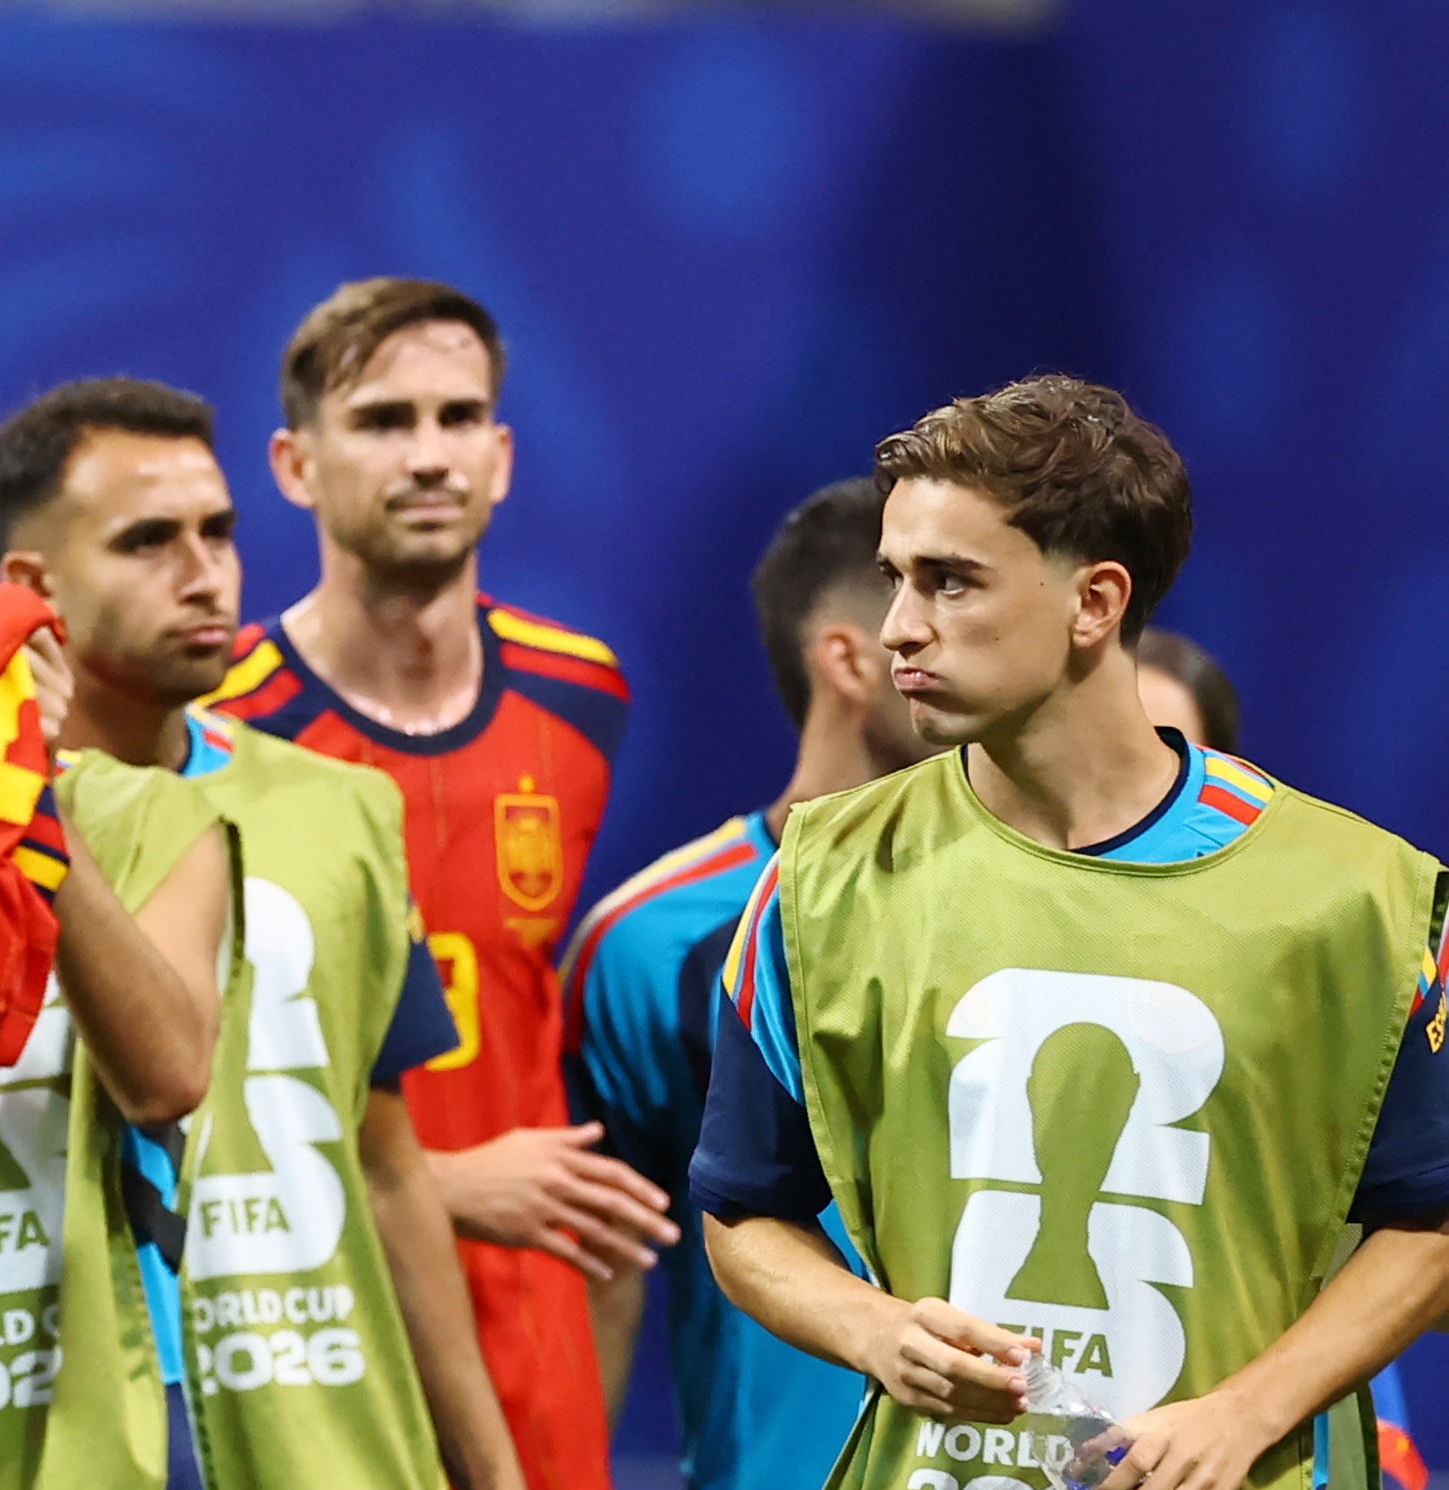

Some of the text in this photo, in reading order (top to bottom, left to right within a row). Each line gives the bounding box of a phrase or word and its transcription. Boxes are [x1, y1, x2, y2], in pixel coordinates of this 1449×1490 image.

[199, 1197, 292, 1239] FIFA
[192, 1284, 355, 1333] ORLD CUP
